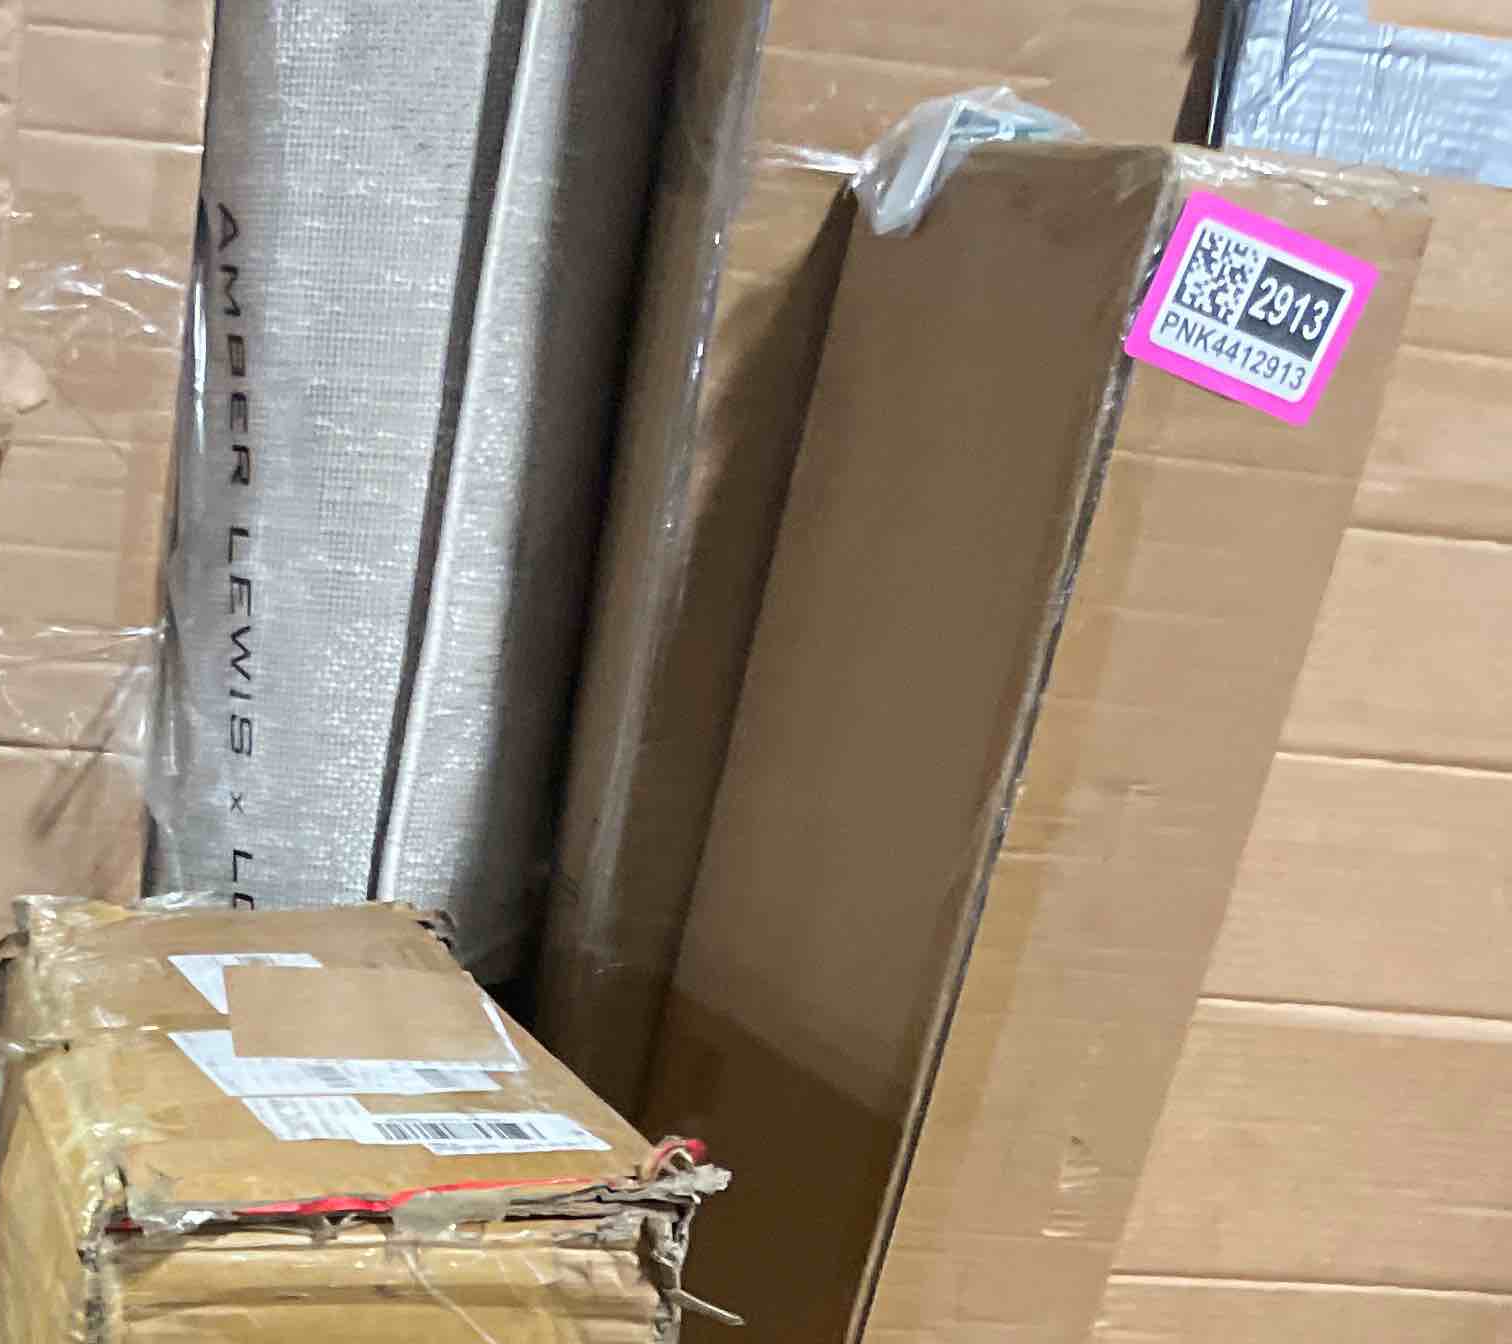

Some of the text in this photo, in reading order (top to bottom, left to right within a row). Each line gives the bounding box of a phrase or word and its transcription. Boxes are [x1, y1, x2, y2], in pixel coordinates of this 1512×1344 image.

[210, 202, 252, 487] AMBER
[1160, 310, 1307, 391] PNK4412913
[1247, 277, 1330, 341] 2913
[228, 526, 254, 758] LEWIS
